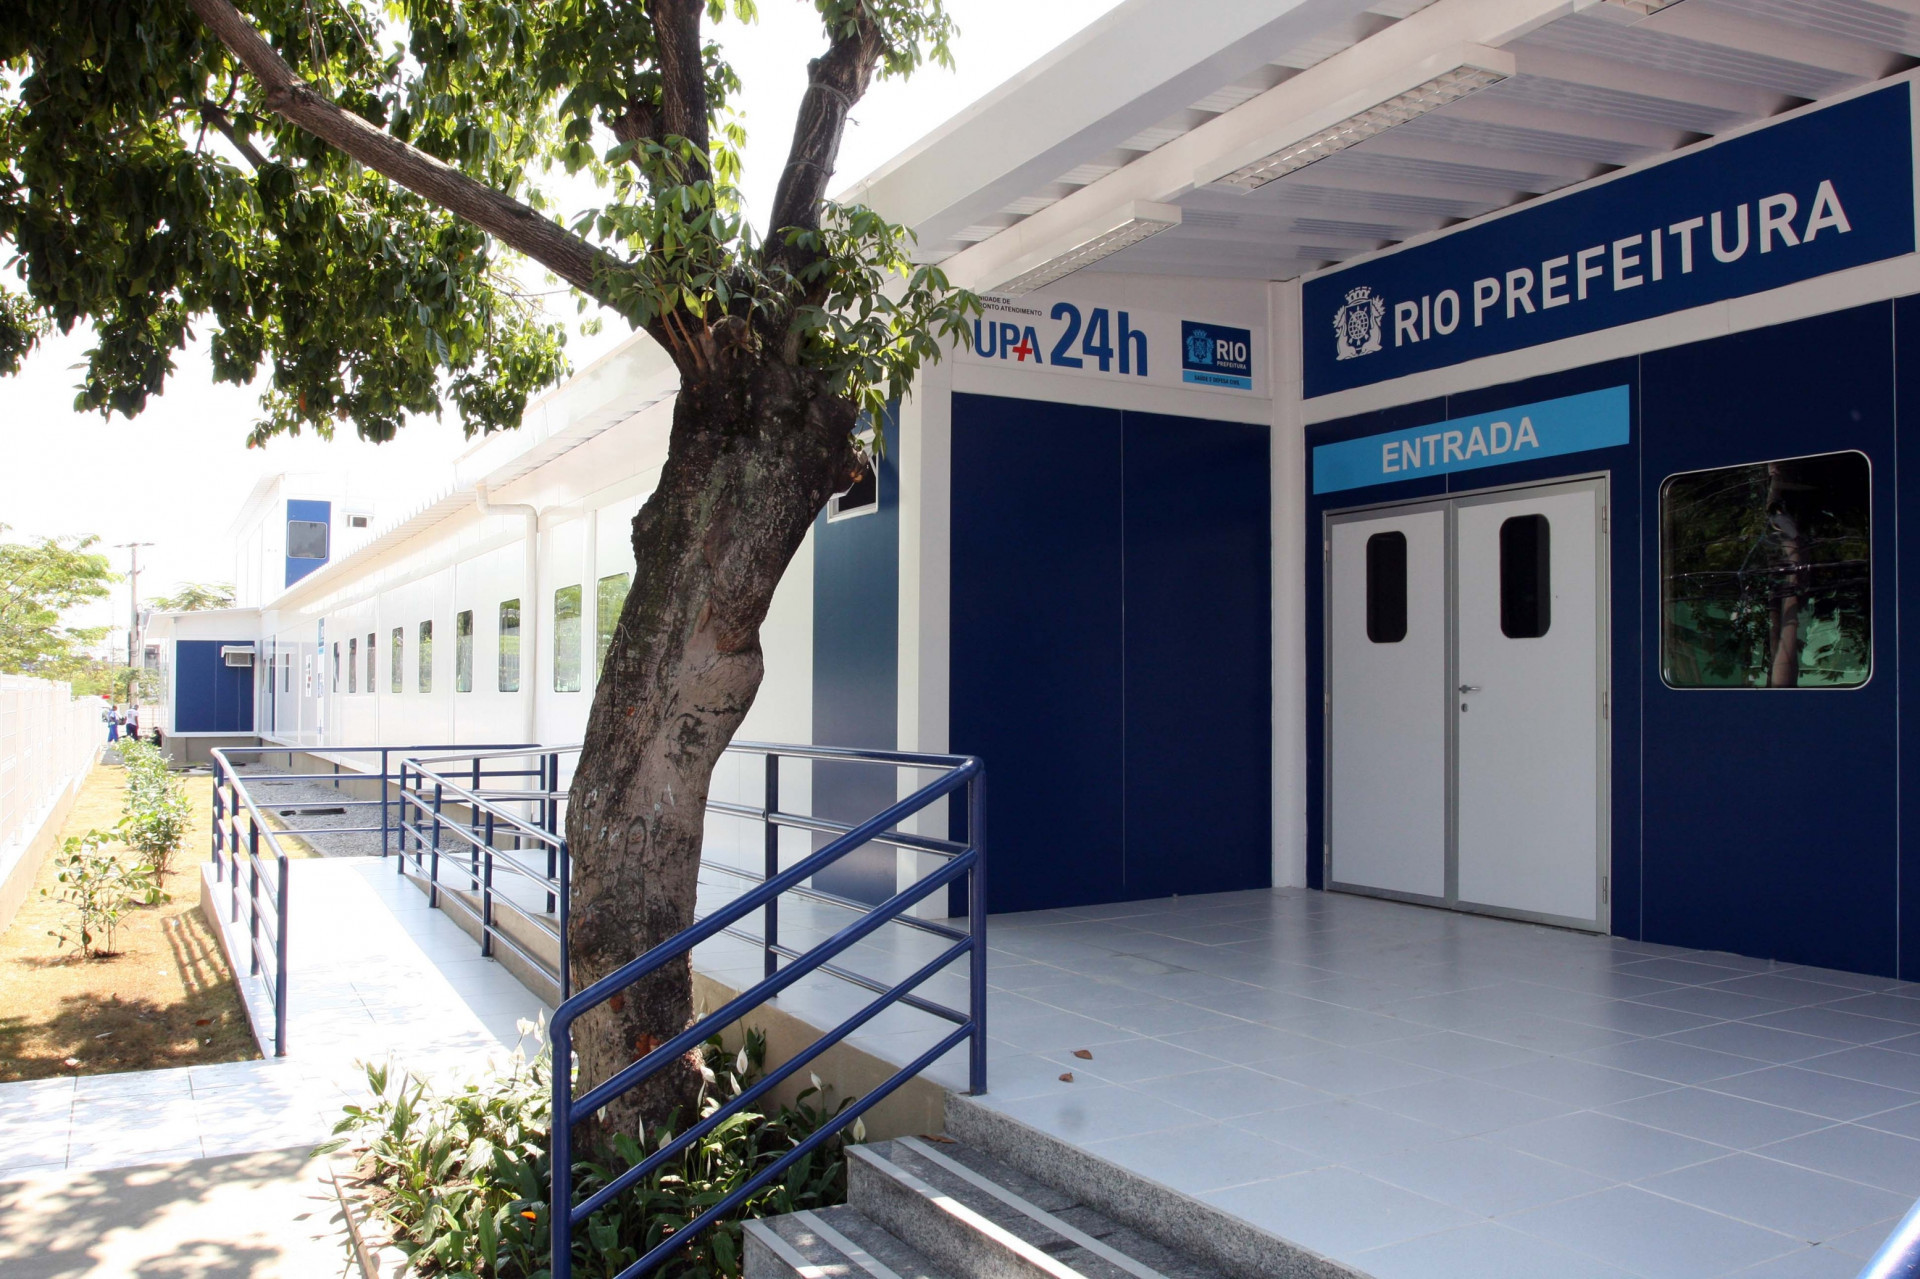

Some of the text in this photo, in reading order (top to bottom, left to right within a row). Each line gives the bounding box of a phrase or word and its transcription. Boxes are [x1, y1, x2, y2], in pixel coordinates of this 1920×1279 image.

[1394, 179, 1852, 347] RIO PREFEITURA
[1001, 305, 1042, 316] ATENDIMENTO
[974, 302, 1148, 377] UPA 24h
[1217, 340, 1247, 362] RIO
[1217, 361, 1247, 370] PREFEITURA
[1382, 416, 1539, 474] ENTRADA
